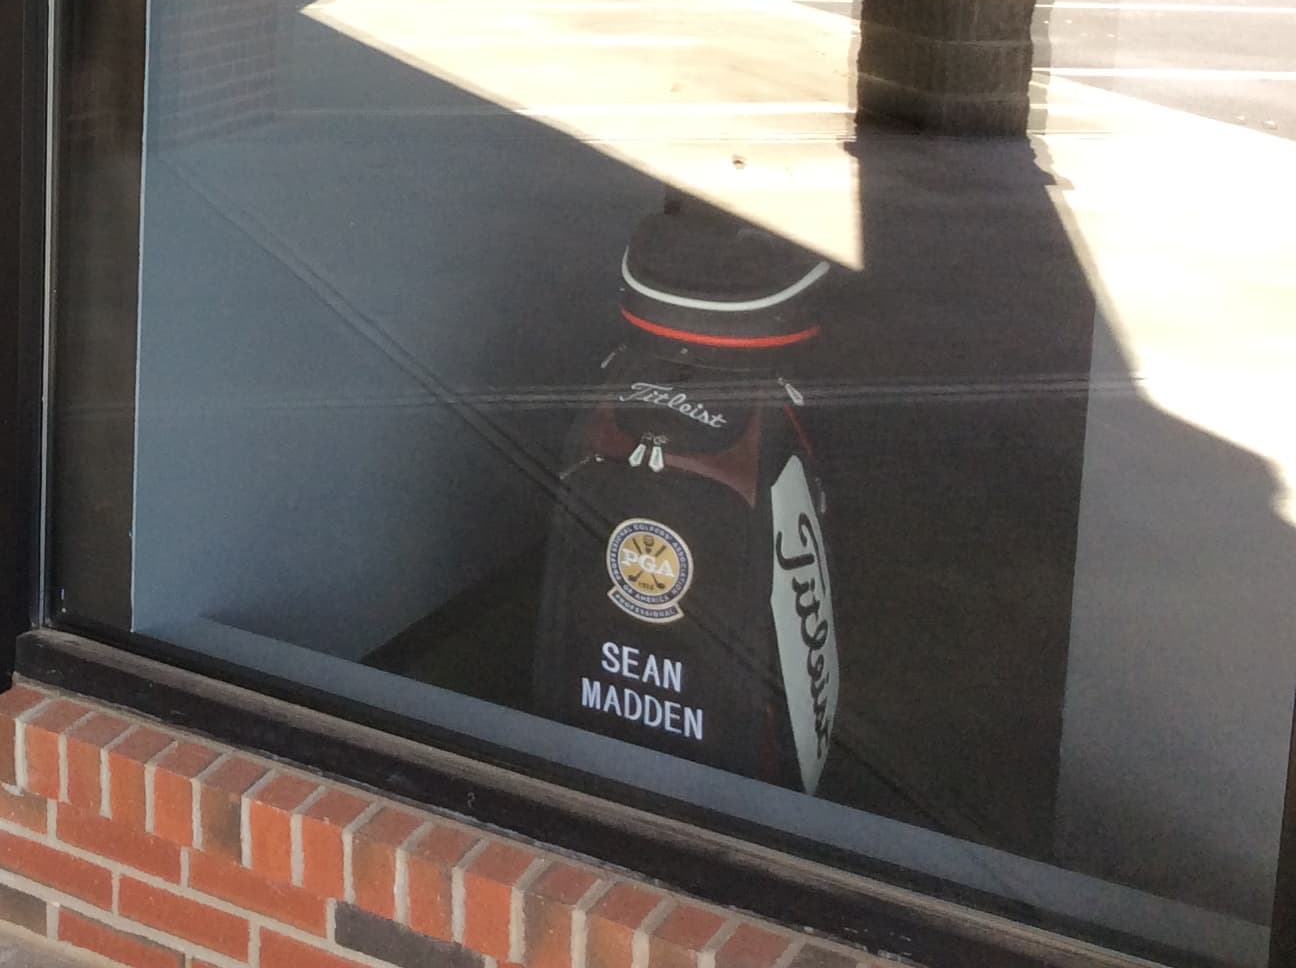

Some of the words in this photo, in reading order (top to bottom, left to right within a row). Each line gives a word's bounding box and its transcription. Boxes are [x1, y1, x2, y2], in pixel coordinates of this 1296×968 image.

[618, 381, 728, 429] Titleist
[621, 547, 675, 578] PGA
[601, 641, 682, 693] SEAN
[581, 677, 703, 740] MADDEN
